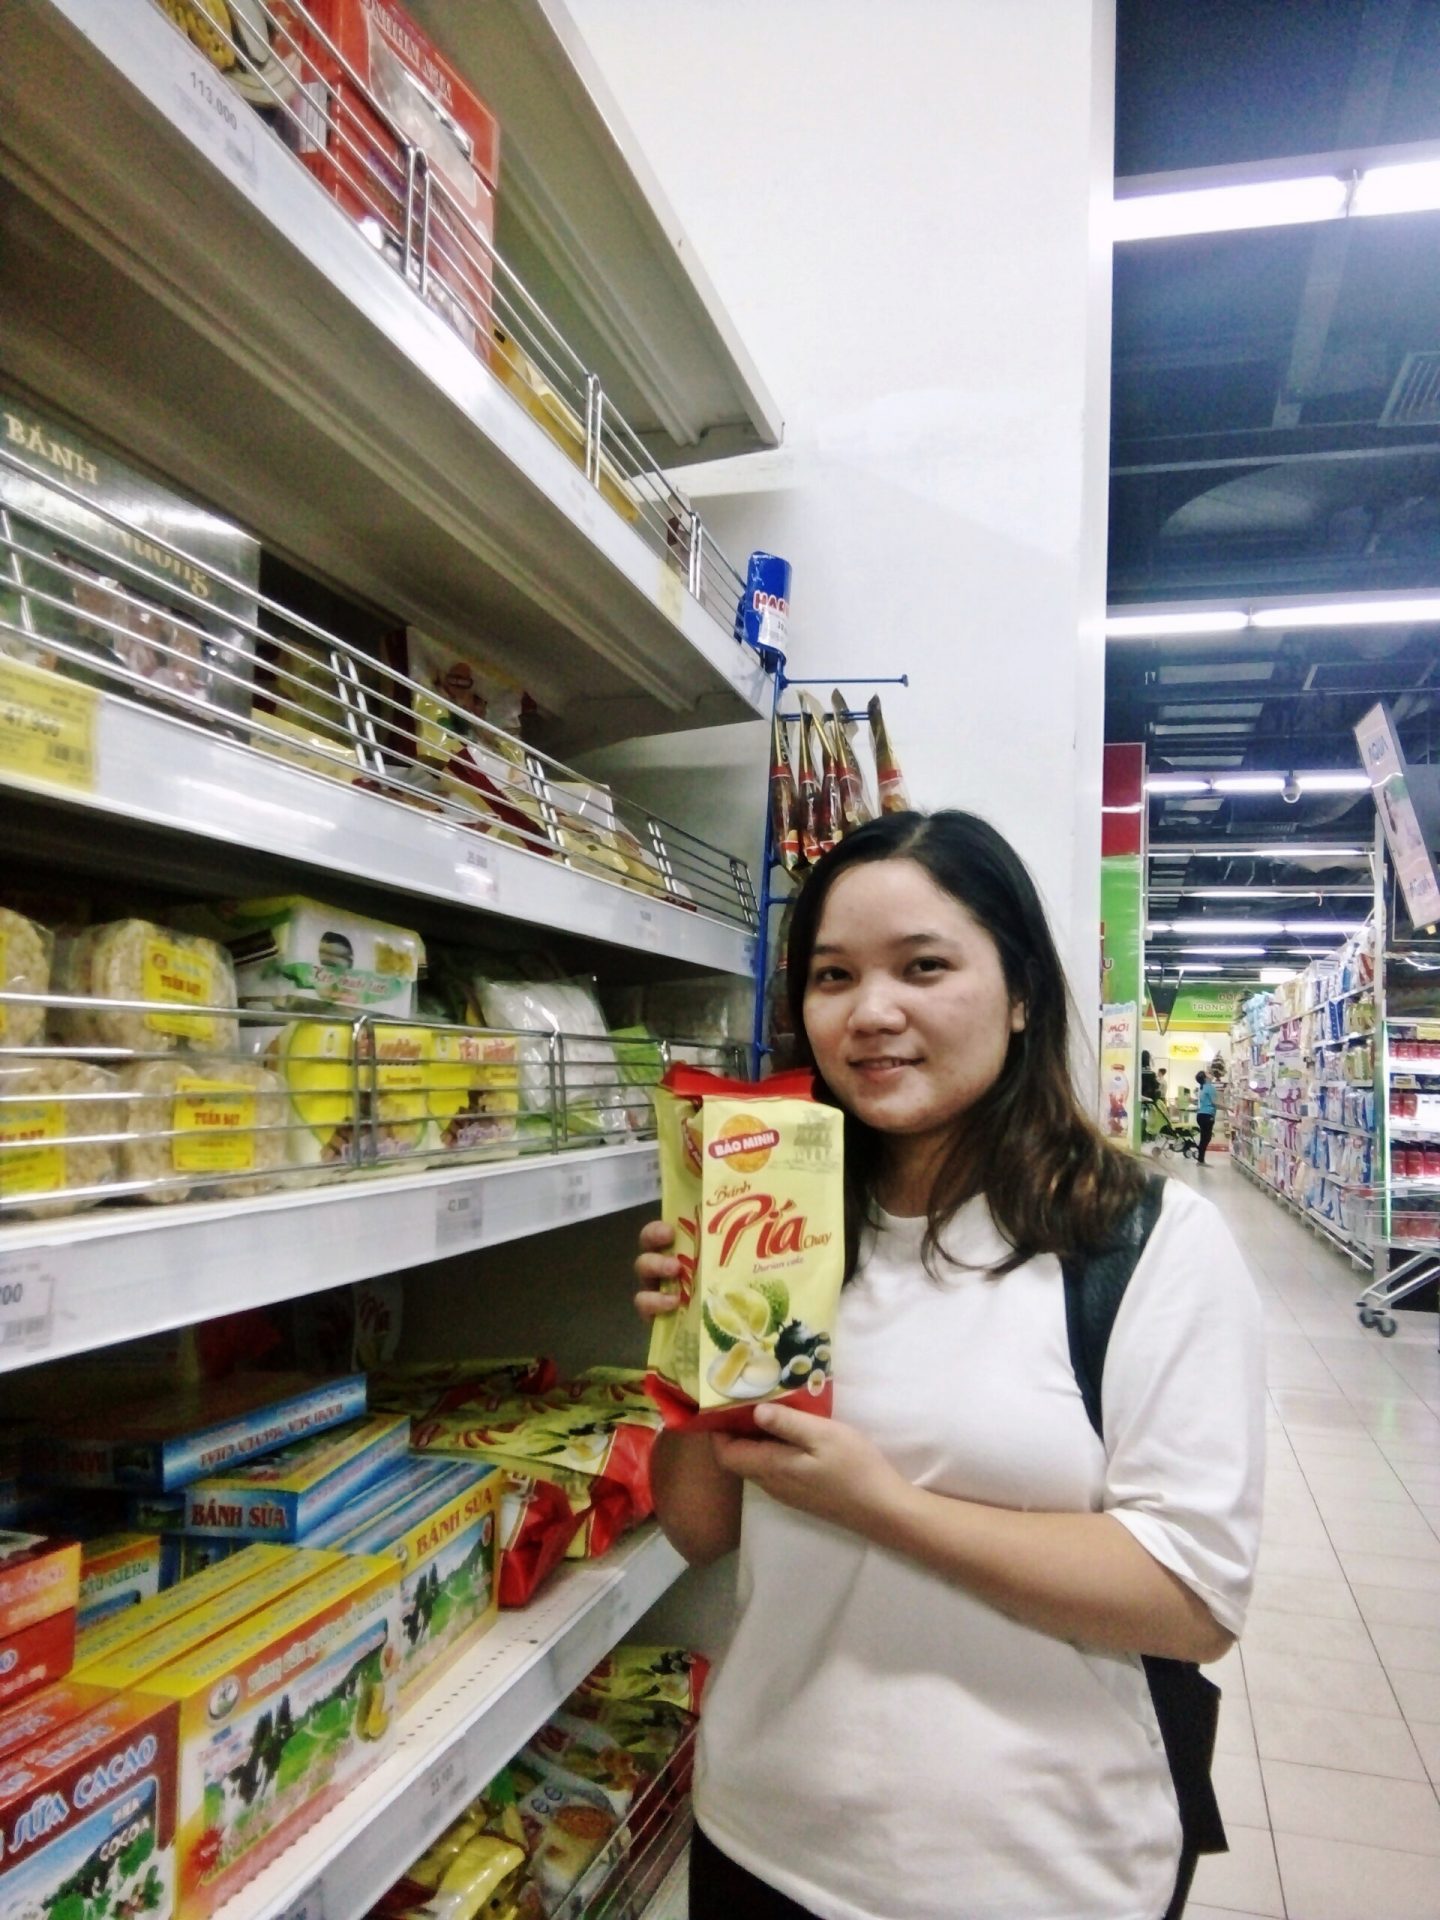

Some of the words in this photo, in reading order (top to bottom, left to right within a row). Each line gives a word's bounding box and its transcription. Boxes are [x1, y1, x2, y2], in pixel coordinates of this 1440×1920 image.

[742, 1131, 775, 1151] MINH
[191, 1497, 244, 1527] BÁNH
[416, 1510, 460, 1557] BÁNH
[73, 1735, 157, 1809] CACAO
